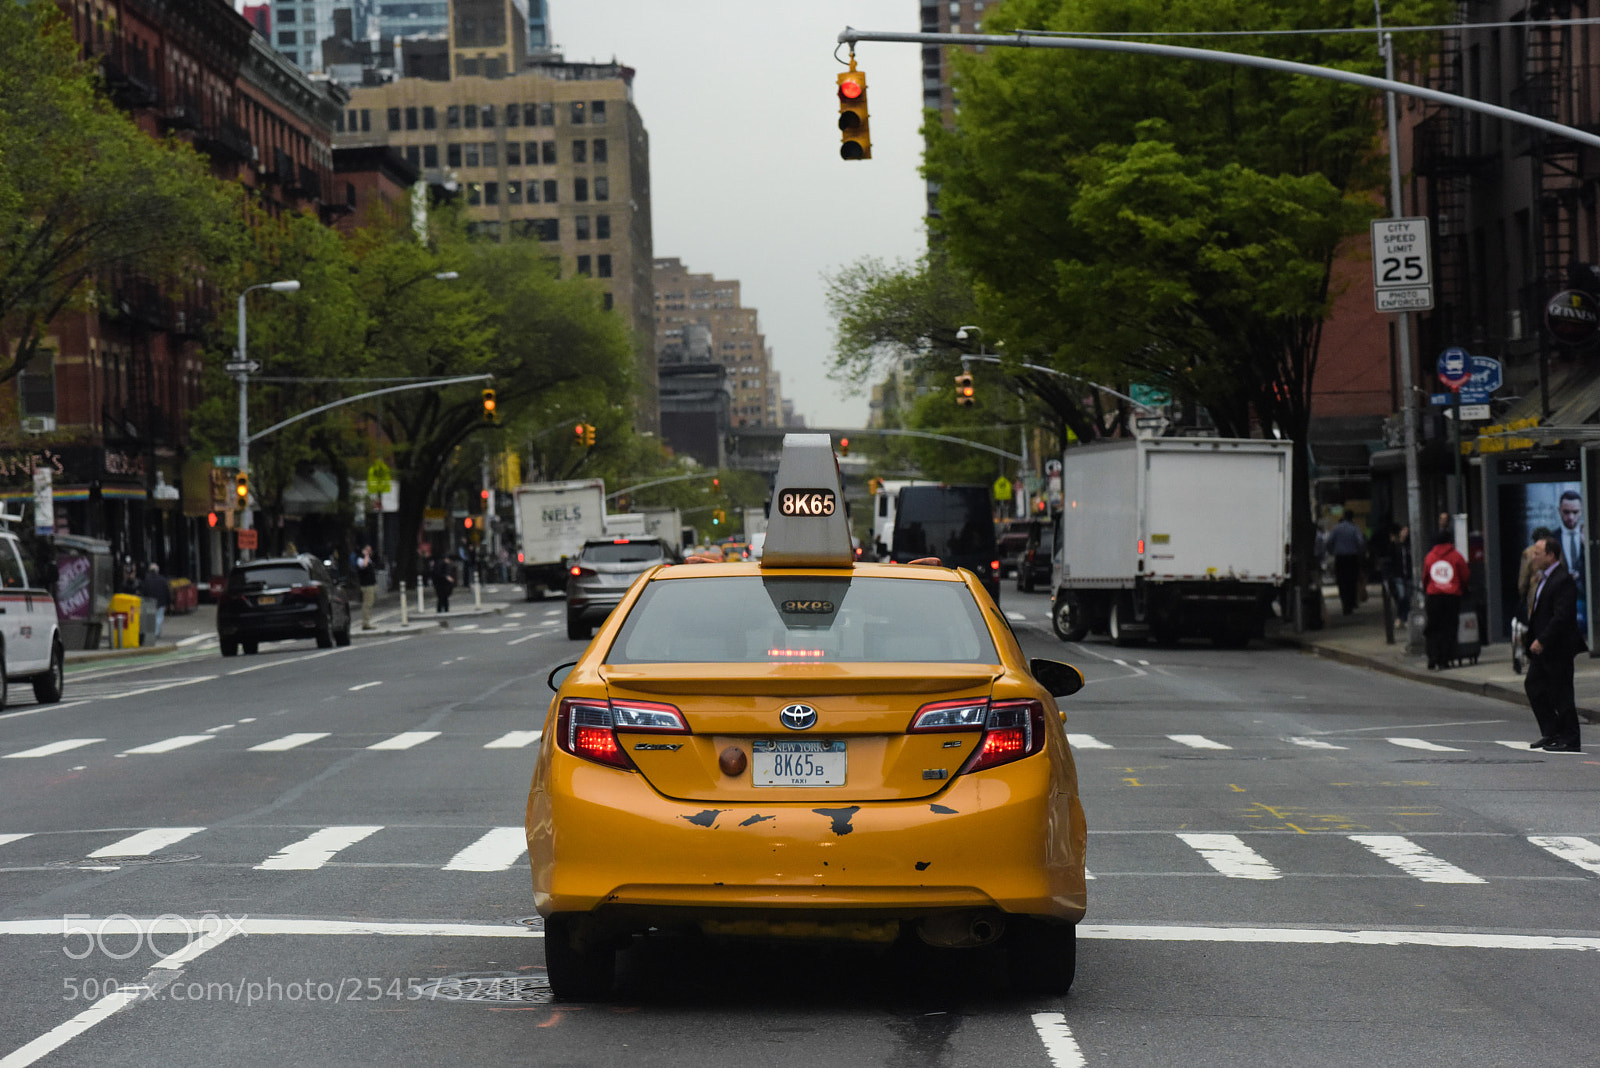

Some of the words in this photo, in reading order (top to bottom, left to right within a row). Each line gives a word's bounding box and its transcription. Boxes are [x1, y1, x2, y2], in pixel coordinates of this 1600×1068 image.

[1388, 223, 1410, 233] CITY
[1384, 234, 1416, 244] SPEED
[1387, 244, 1413, 254] LIMIT
[1382, 256, 1423, 282] 25
[1389, 290, 1418, 299] PHOTO
[1381, 298, 1427, 307] ENFORCED
[782, 493, 835, 516] 8K65
[776, 742, 796, 752] NEW
[799, 742, 823, 752] YORK
